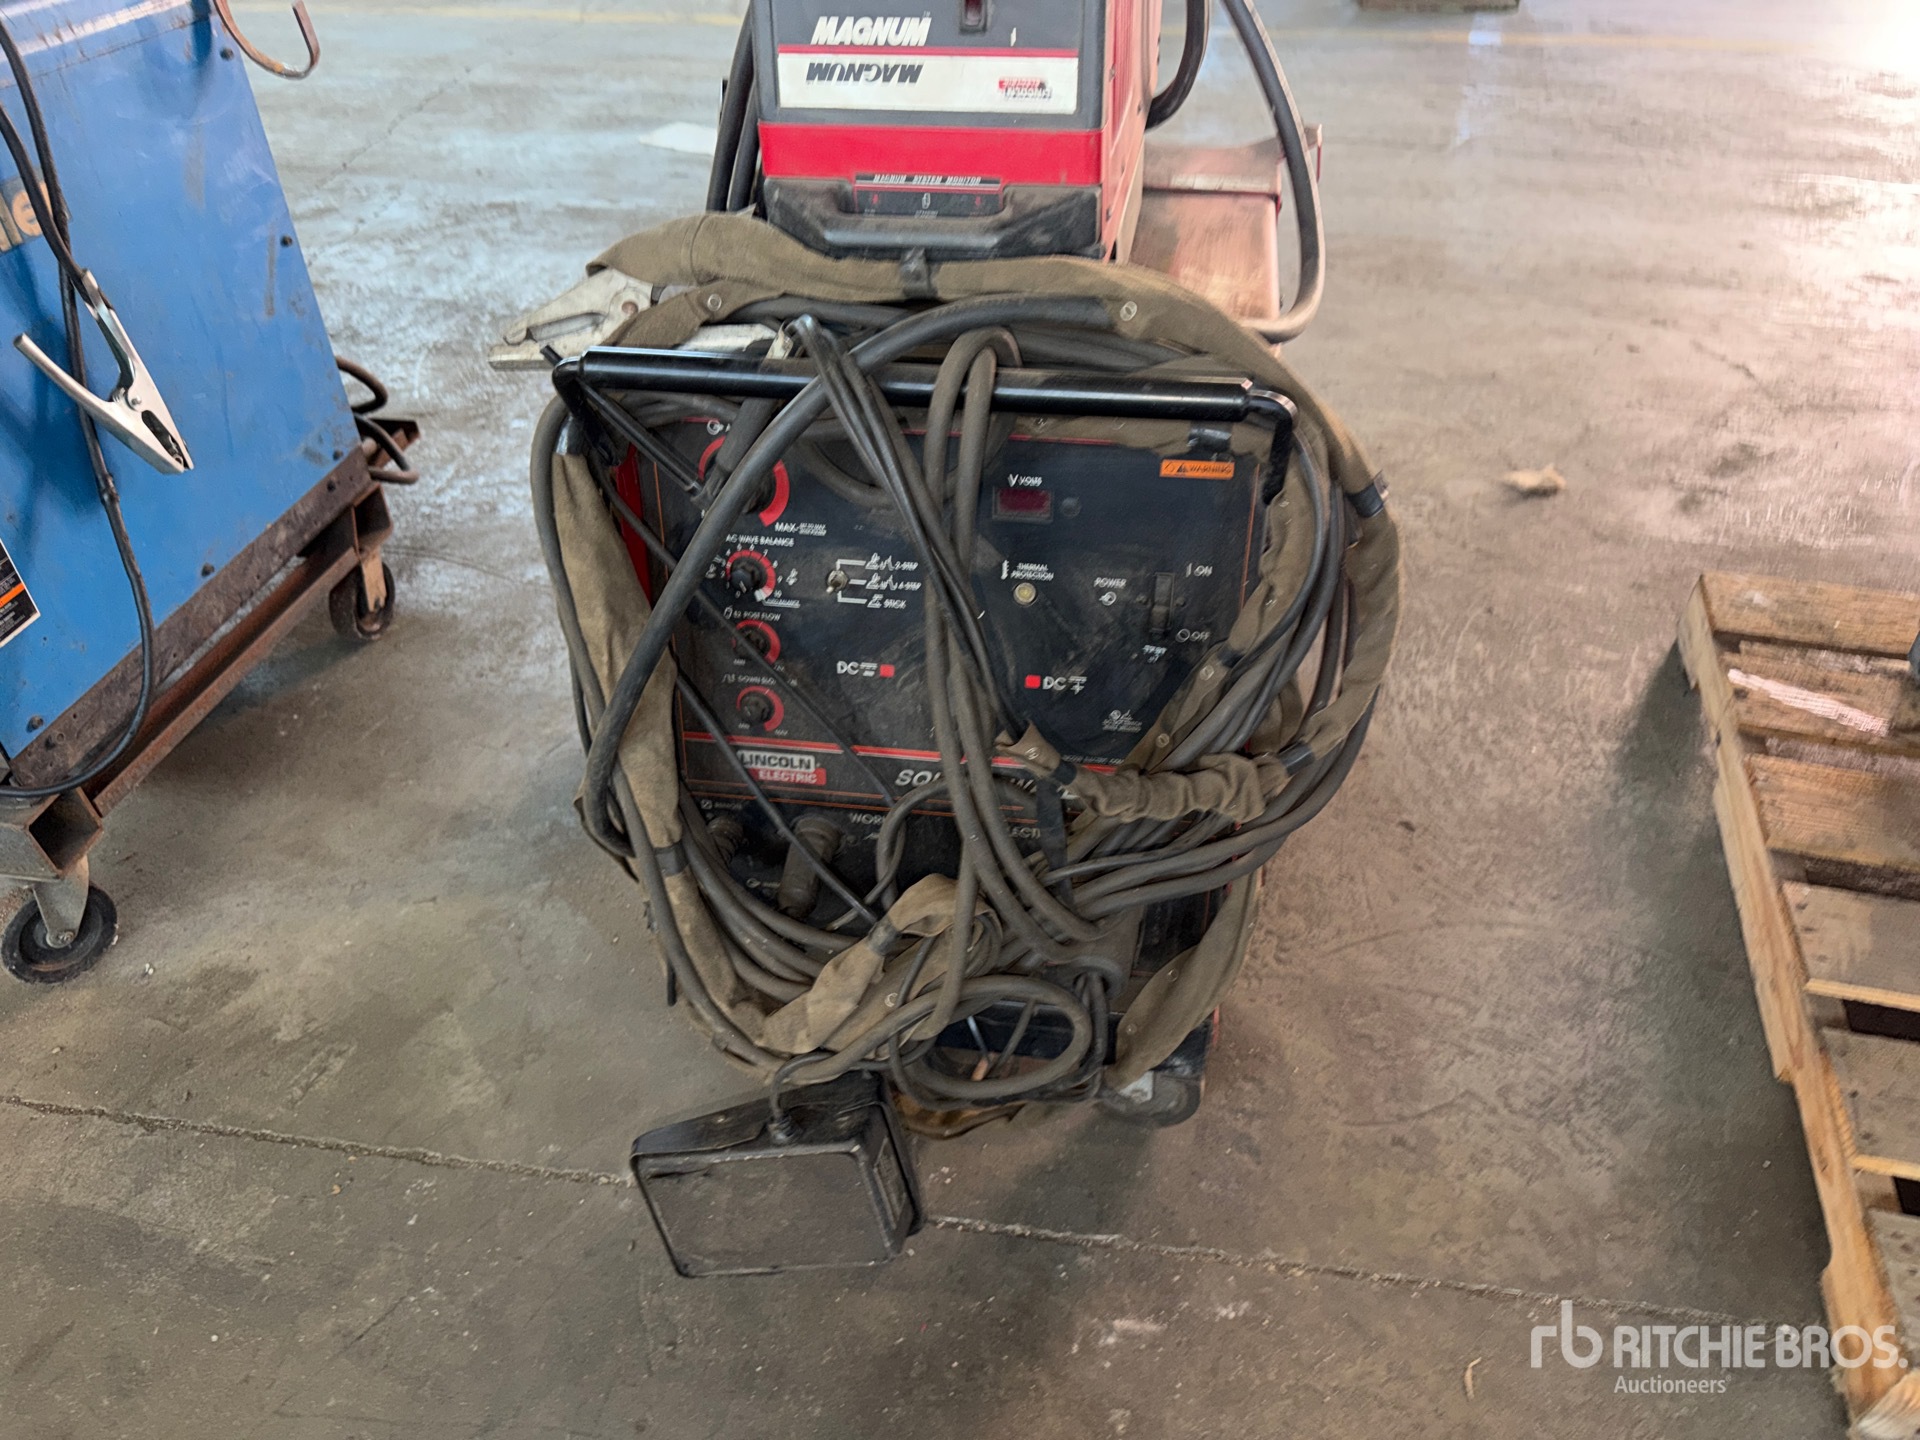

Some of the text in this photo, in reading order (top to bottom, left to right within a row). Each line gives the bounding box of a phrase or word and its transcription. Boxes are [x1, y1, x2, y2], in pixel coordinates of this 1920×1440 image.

[810, 16, 932, 47] MAGNUM
[806, 62, 924, 84] MAGNUM
[873, 174, 981, 187] MAGNUM SYSTEM MONITOR
[739, 535, 759, 544] WAVE
[760, 536, 795, 547] BALANCE
[1093, 577, 1127, 588] POWER
[741, 753, 811, 770] LINCOLN
[758, 769, 818, 784] ELECTRIC
